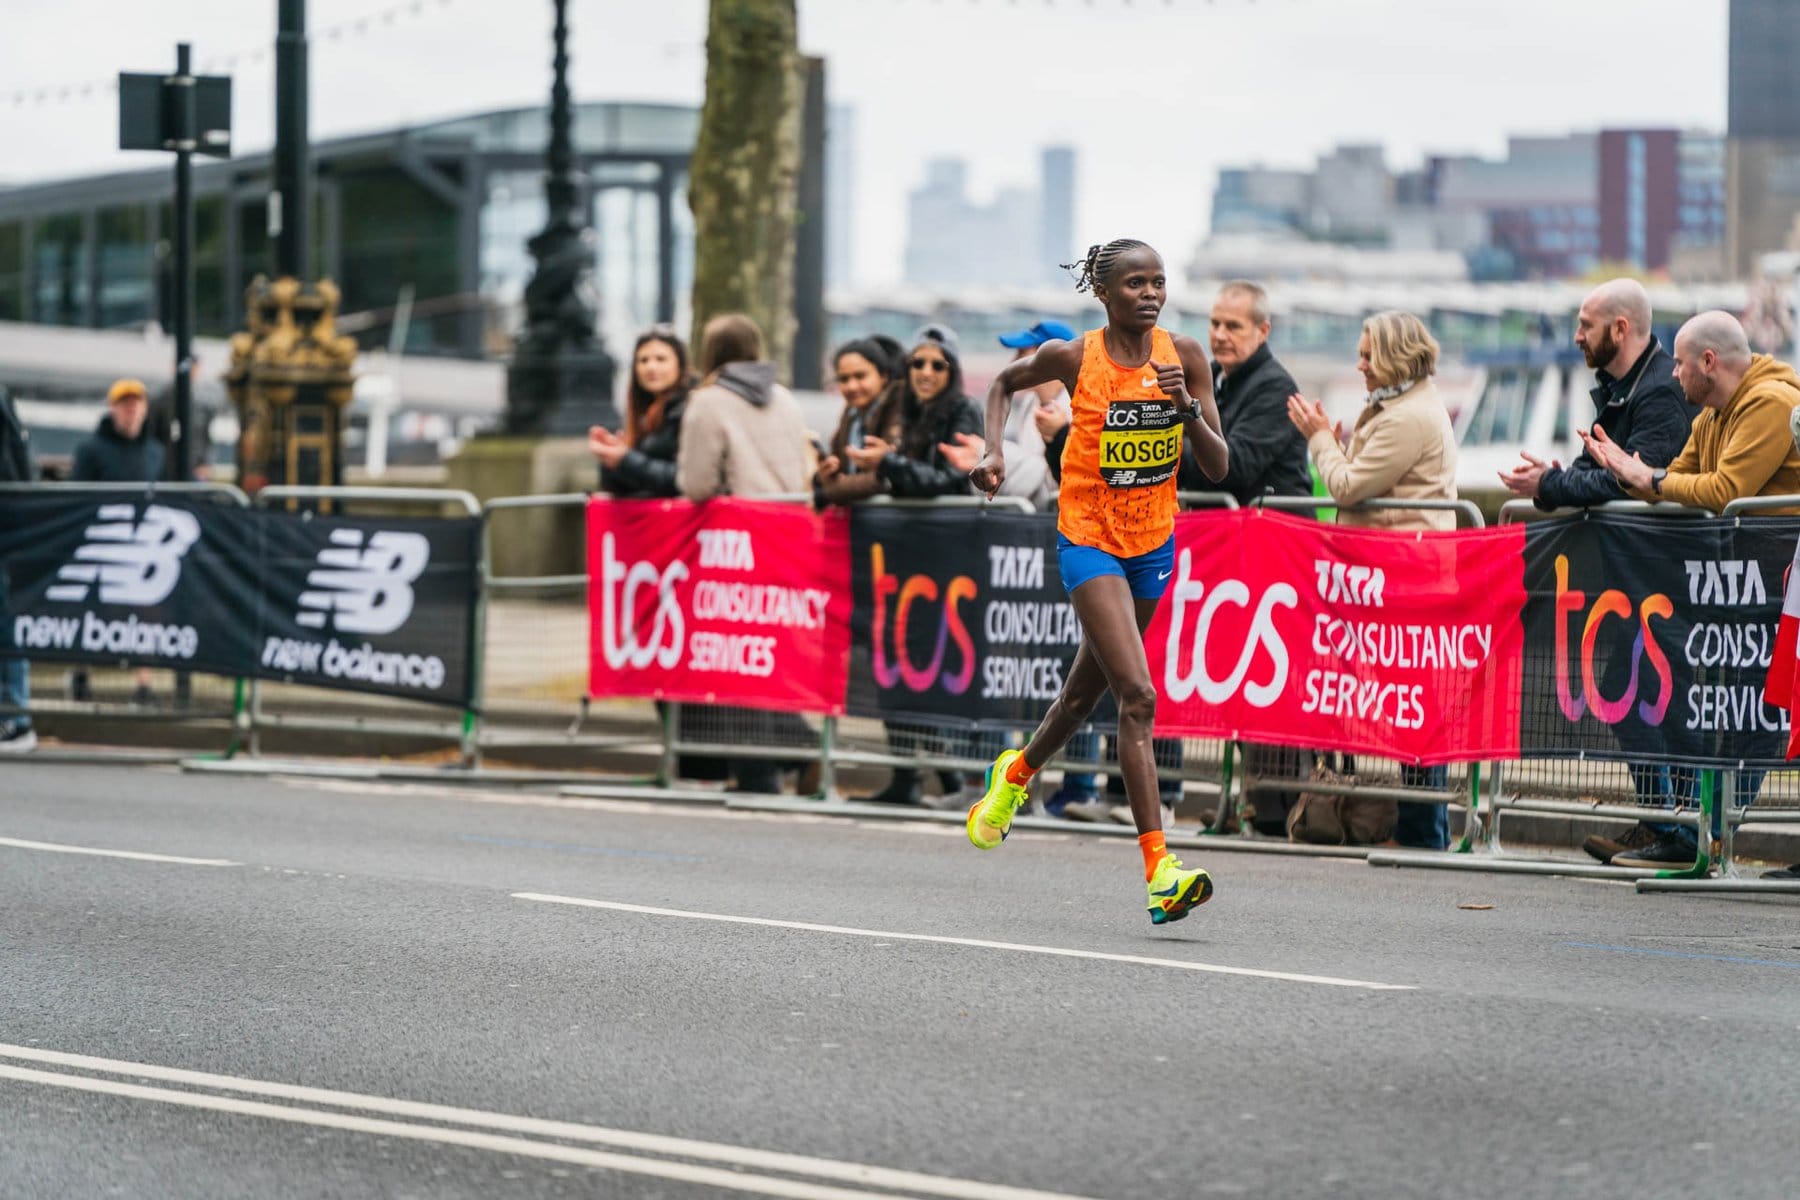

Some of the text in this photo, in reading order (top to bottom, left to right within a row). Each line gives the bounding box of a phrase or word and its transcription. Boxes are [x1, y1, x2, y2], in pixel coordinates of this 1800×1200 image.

[1106, 408, 1138, 426] tcs
[1141, 417, 1170, 426] SERVICES
[1106, 434, 1178, 463] KOSGEI
[1136, 477, 1151, 486] new
[696, 529, 755, 571] TATA
[988, 545, 1045, 589] TATA
[602, 531, 690, 669] tcs
[692, 580, 831, 630] CONSULTANCY
[1314, 559, 1386, 607] TATA
[1684, 559, 1767, 605] TATA
[14, 611, 198, 659] new balance
[871, 542, 977, 695] tcs
[1164, 547, 1298, 708] tcs
[1312, 613, 1492, 669] CONSULTANCY
[1554, 553, 1674, 726] tcs
[262, 635, 446, 690] new balance
[688, 631, 777, 677] SERVICES
[981, 656, 1063, 700] SERVICES
[1302, 669, 1425, 730] SERVICES
